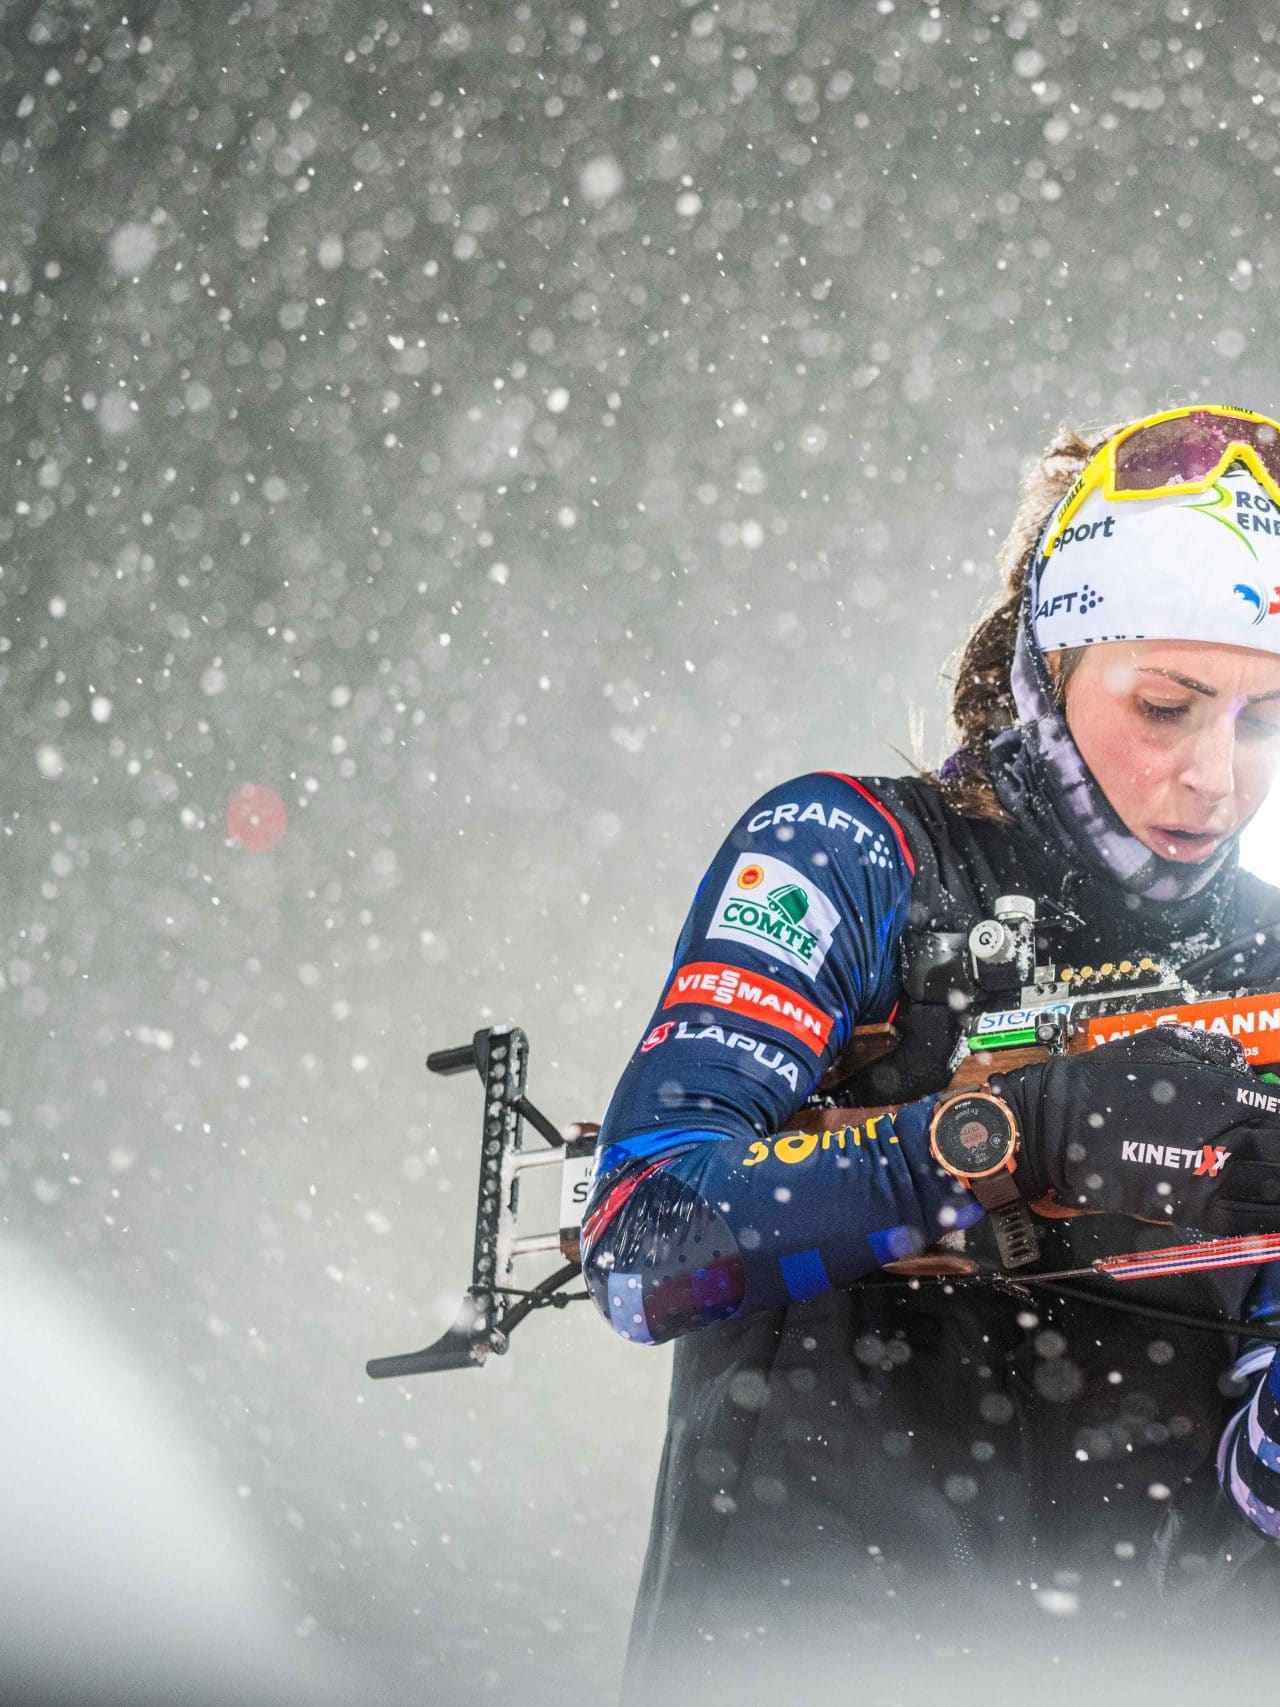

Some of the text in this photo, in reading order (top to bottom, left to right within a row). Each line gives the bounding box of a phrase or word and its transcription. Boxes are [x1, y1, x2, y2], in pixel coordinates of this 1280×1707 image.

[1035, 592, 1078, 620] AFT
[747, 803, 872, 844] CRAFT
[678, 969, 822, 1036] VIESSMANN
[675, 1022, 798, 1092] LAPUA
